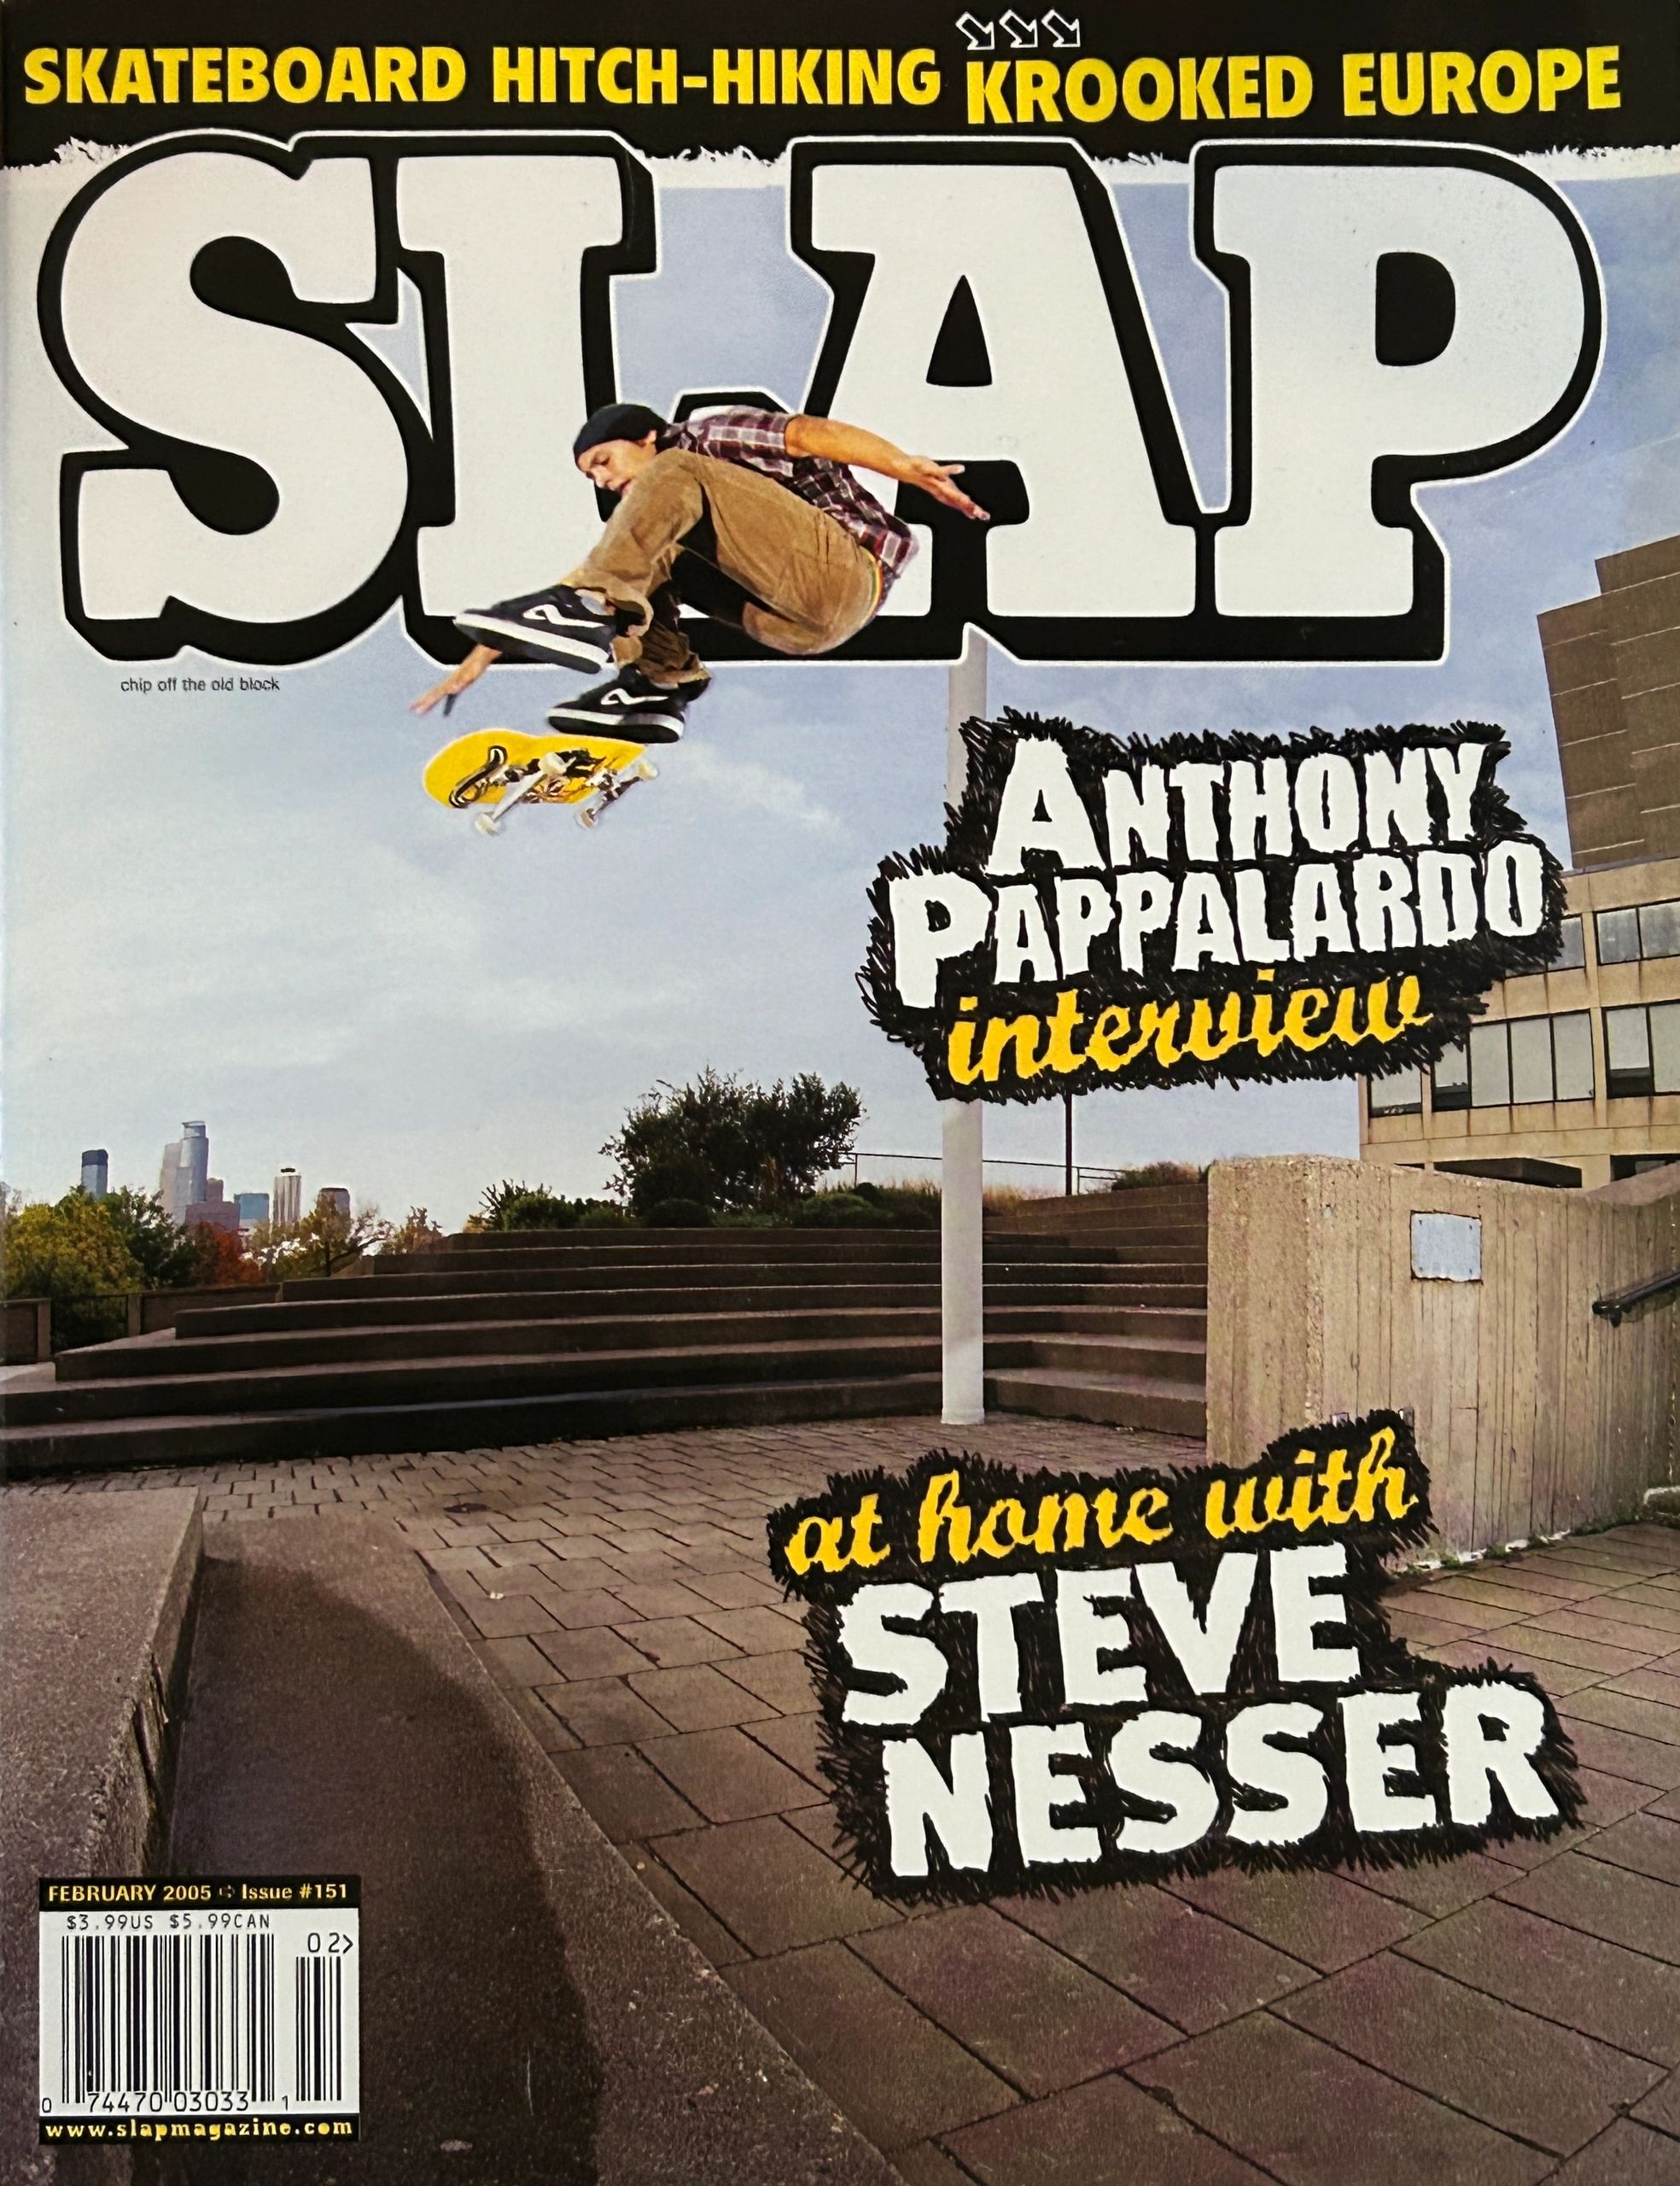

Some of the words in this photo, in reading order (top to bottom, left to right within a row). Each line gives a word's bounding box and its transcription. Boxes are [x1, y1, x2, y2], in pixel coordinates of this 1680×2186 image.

[23, 47, 466, 105] SKATEBOARD
[492, 48, 942, 106] HITCH-HIKING
[966, 56, 1313, 125] KROOKED
[1343, 45, 1622, 117] EUROPE
[38, 132, 1605, 662] SLAP
[120, 677, 152, 693] chip
[157, 677, 178, 692] off
[182, 677, 207, 691] the
[211, 677, 235, 691] old
[240, 677, 280, 691] block
[986, 738, 1490, 876] ANTHONY
[889, 840, 1543, 1008] PAPPALARDO
[947, 968, 1434, 1086] interview
[784, 1493, 891, 1575] at
[917, 1469, 1172, 1564] home
[1205, 1426, 1419, 1540] with
[836, 1541, 1361, 1727] STEVE
[882, 1680, 1559, 1877] NESSER
[49, 1884, 157, 1903] FEBRUARY
[163, 1885, 212, 1901] 2005
[242, 1885, 293, 1901] Issue
[299, 1883, 347, 1900] #151
[66, 1914, 154, 1931] $3.99US
[169, 1913, 271, 1929] $5.99CAN
[41, 2097, 52, 2113] 0
[87, 2092, 163, 2113] 74470
[173, 2091, 249, 2112] 03033
[282, 2095, 289, 2111] 1
[44, 2118, 353, 2142] www.slapmagazine.com
